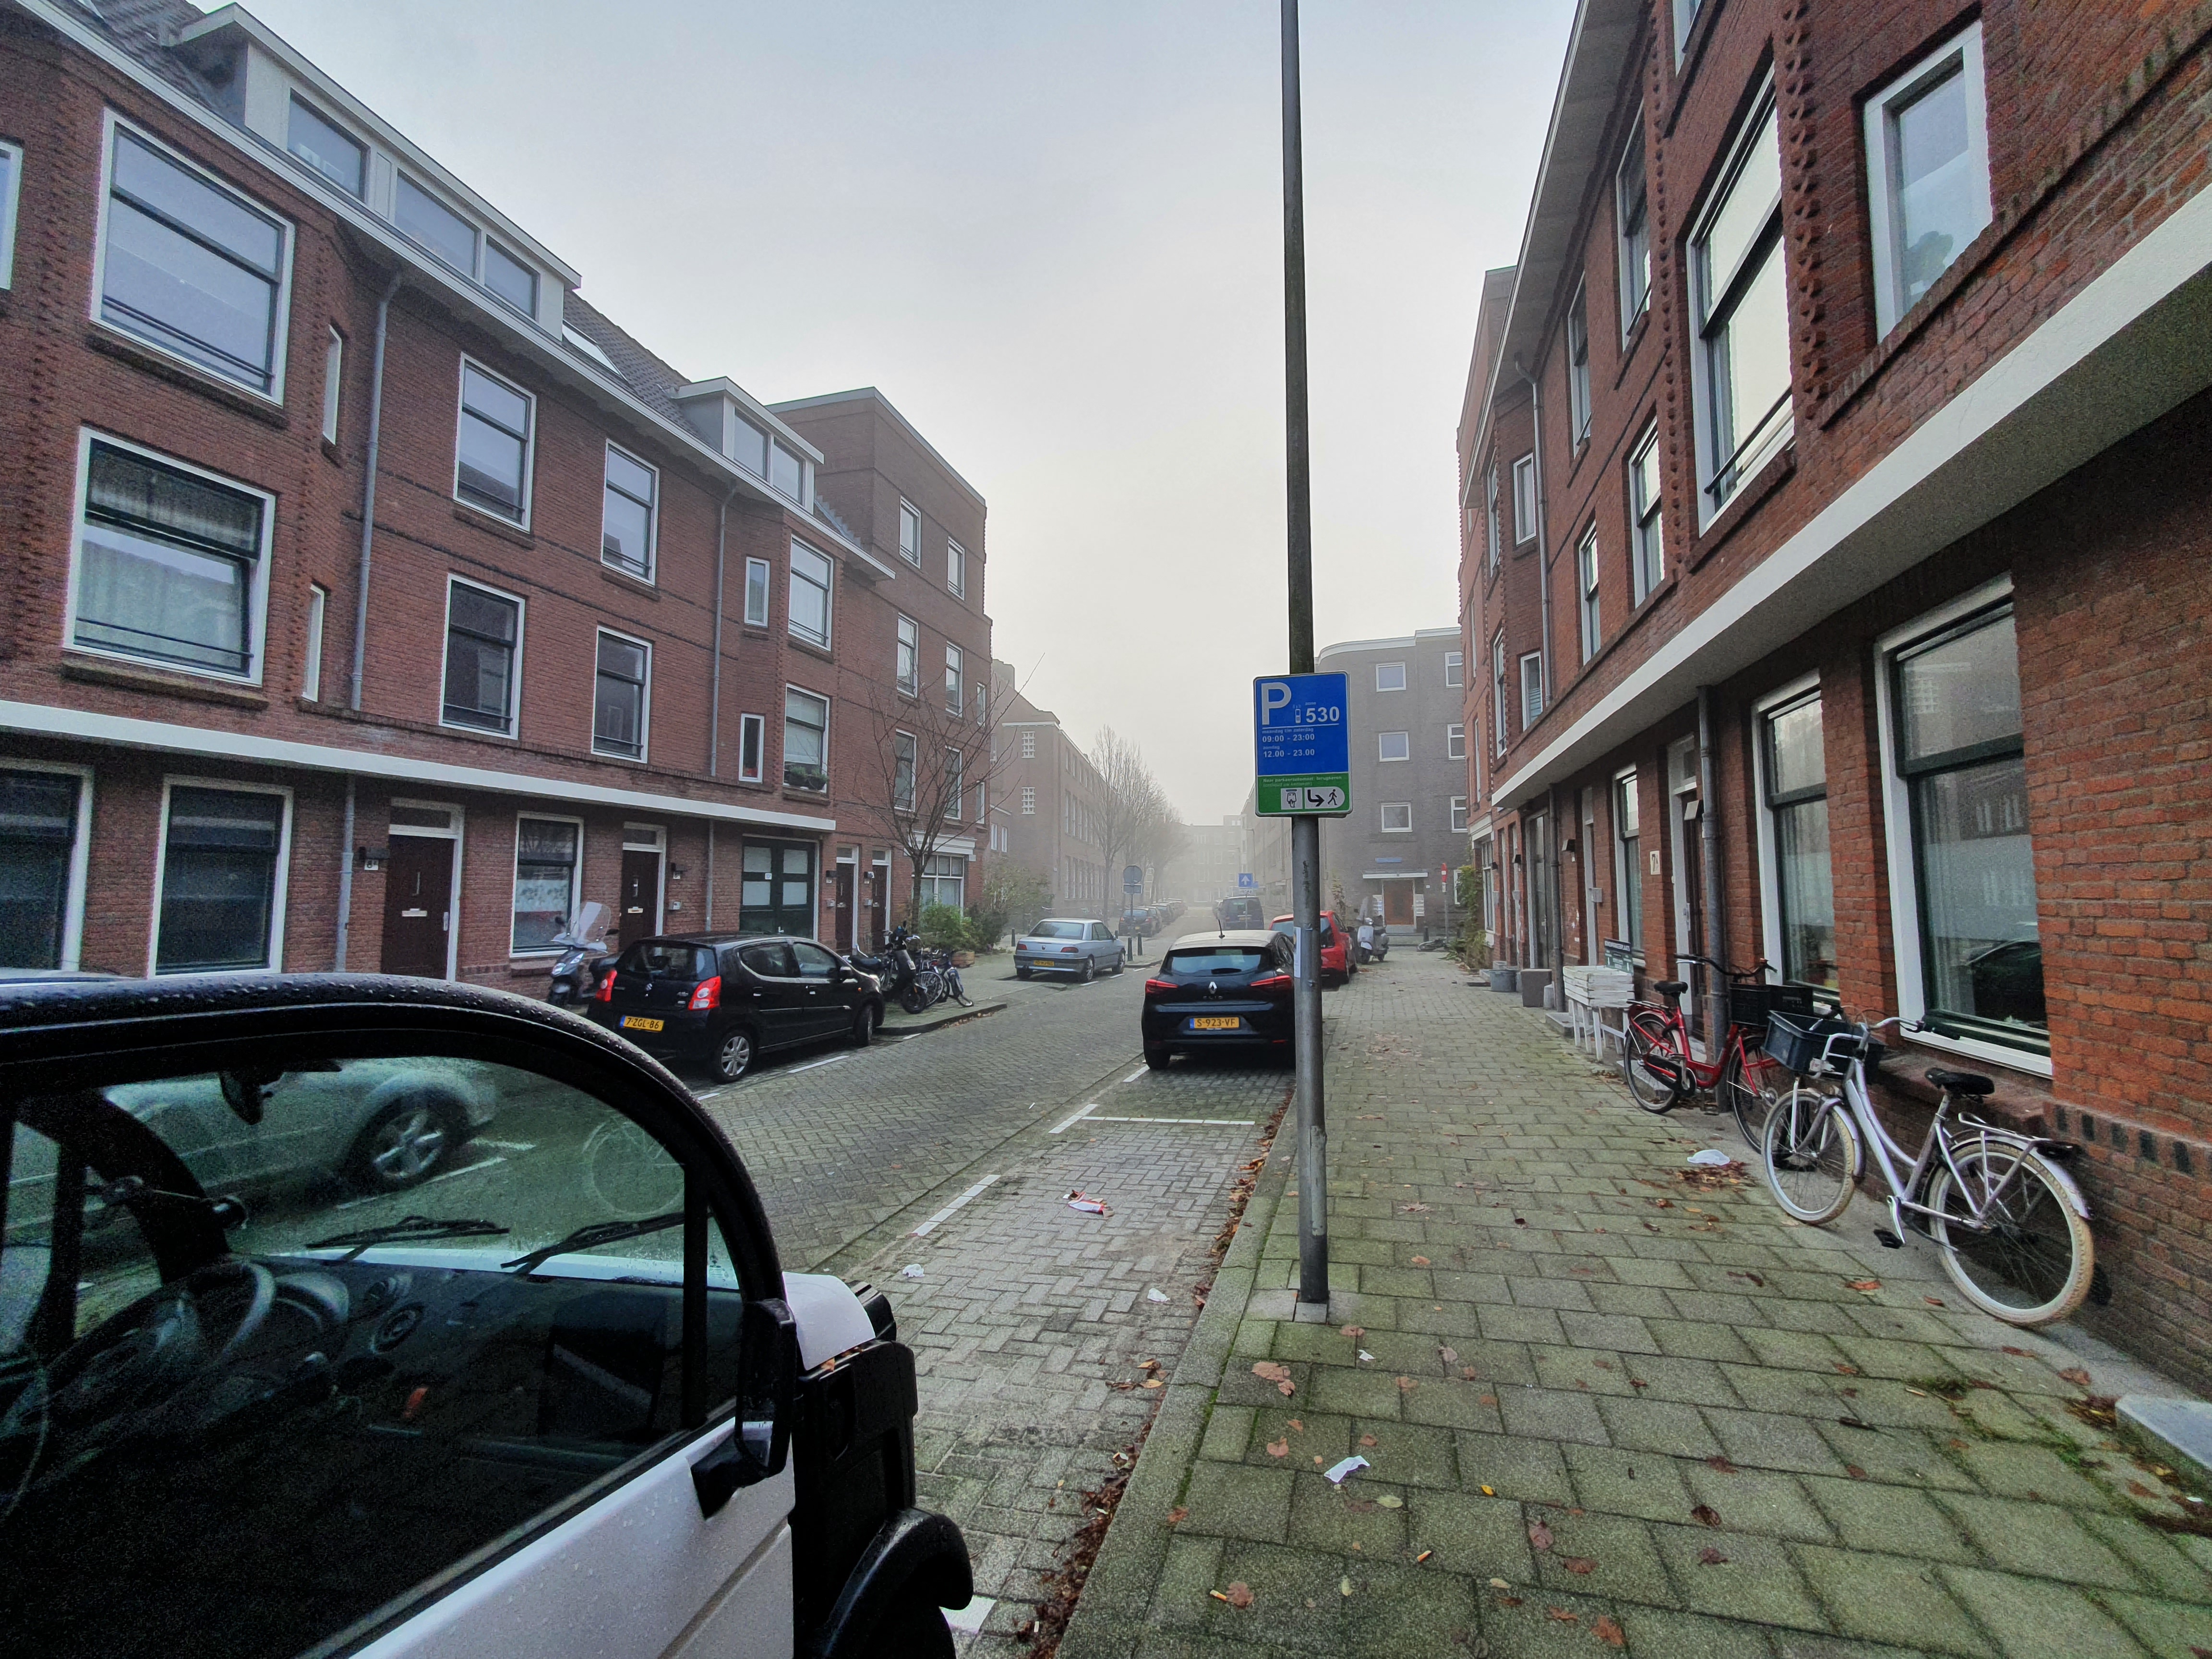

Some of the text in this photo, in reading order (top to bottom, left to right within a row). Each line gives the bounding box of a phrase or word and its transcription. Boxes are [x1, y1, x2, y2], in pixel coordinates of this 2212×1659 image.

[1261, 682, 1291, 725] P
[1306, 706, 1339, 722] 530
[626, 1017, 660, 1029] 7-ZGL-86
[1197, 1018, 1236, 1027] S-923-VF
